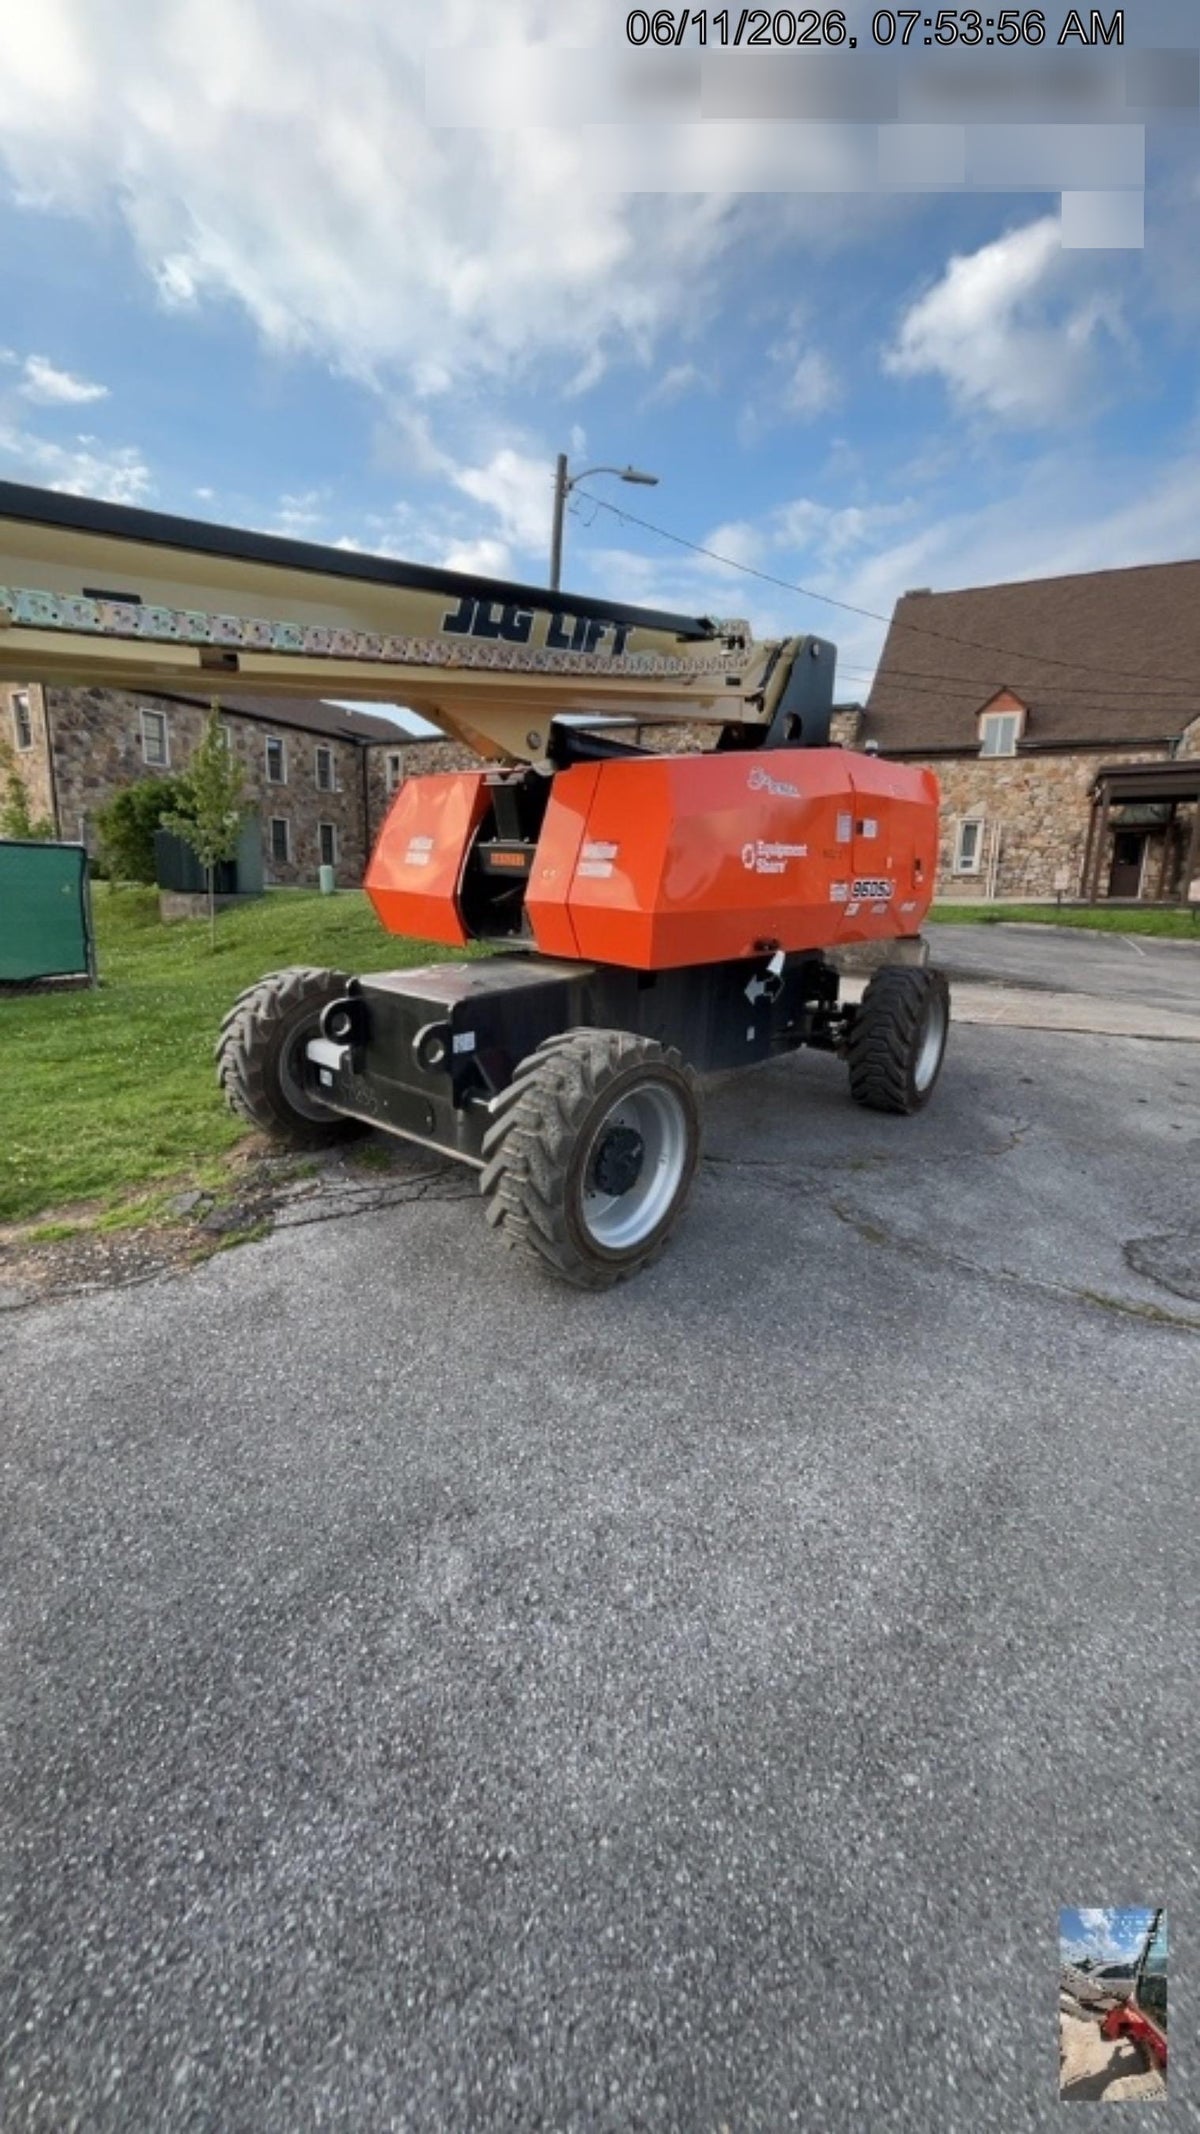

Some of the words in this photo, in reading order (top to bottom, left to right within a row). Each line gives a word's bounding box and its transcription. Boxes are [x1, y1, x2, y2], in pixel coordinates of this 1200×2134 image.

[442, 597, 535, 645] JLG
[544, 610, 636, 655] LIFT
[757, 840, 808, 859] Equipment
[756, 858, 786, 873] Share
